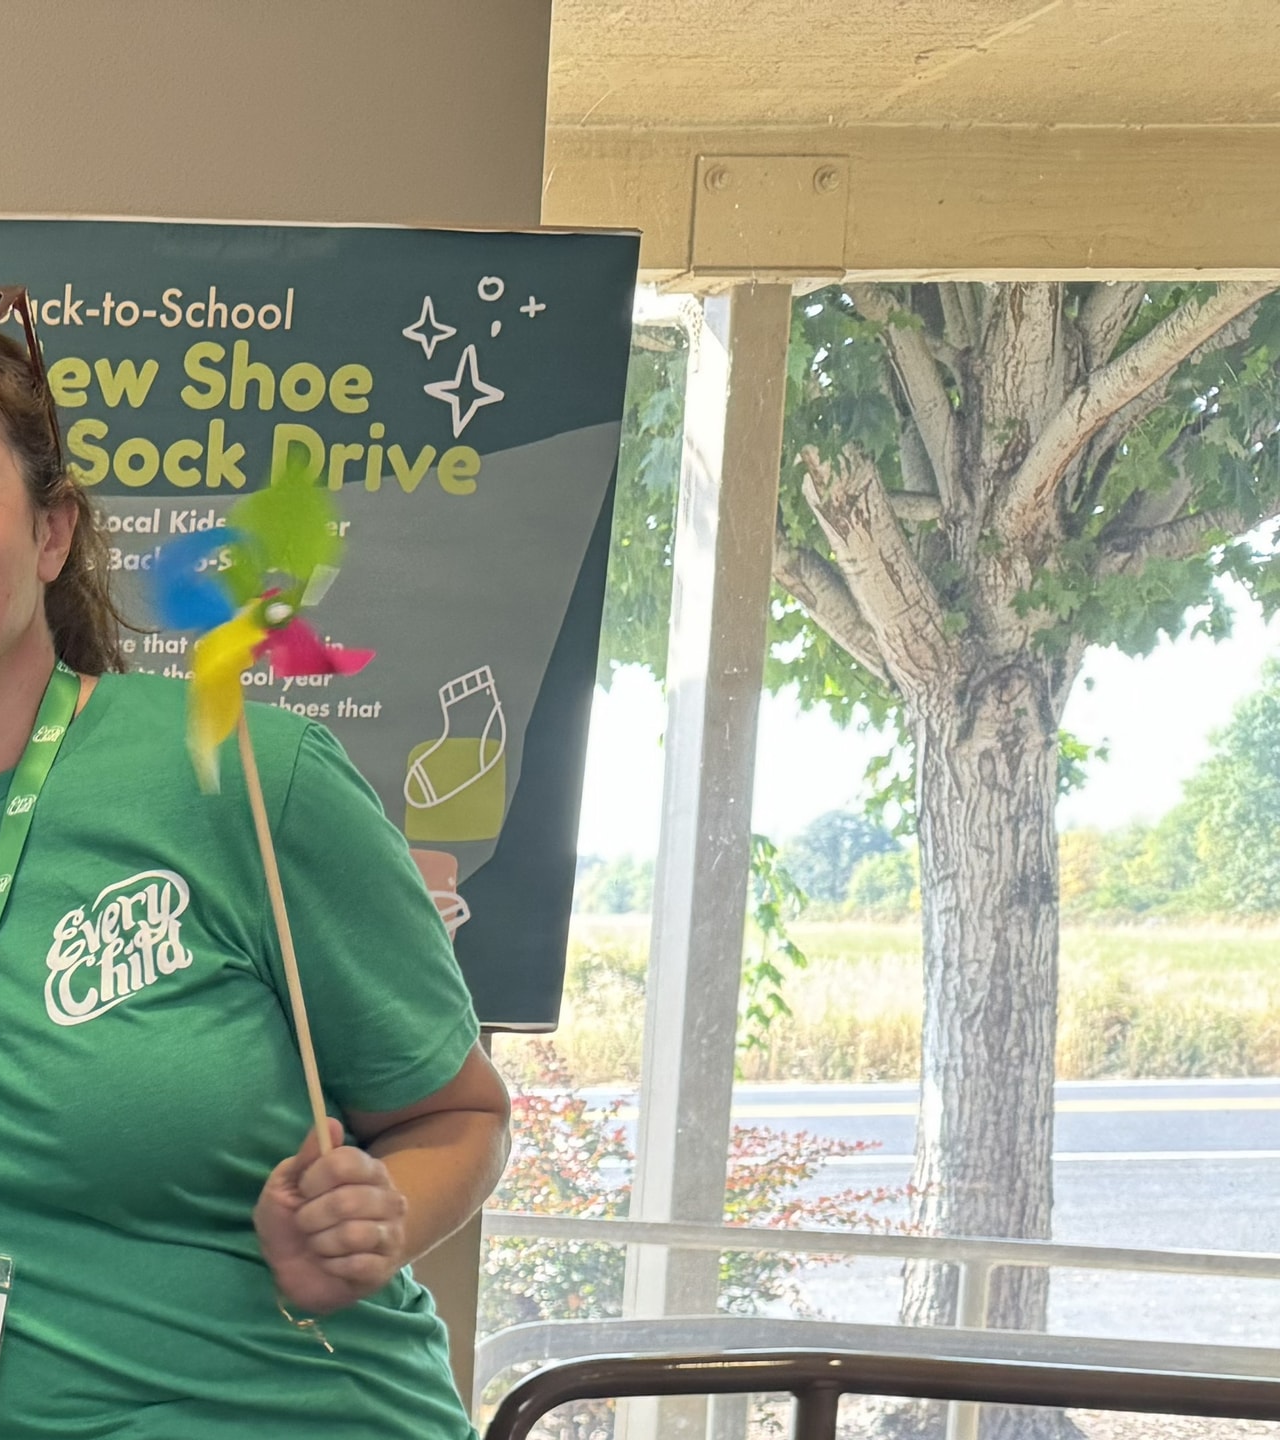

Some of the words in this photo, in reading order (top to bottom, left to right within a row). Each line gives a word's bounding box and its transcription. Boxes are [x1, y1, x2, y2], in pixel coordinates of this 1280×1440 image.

[0, 283, 294, 330] ck-to-School
[180, 339, 374, 413] Shoe
[67, 416, 246, 490] Sock
[270, 421, 481, 495] Drive
[143, 637, 188, 654] that
[282, 672, 333, 691] year
[338, 697, 382, 718] that
[52, 876, 185, 977] Every
[47, 925, 192, 1023] Child
